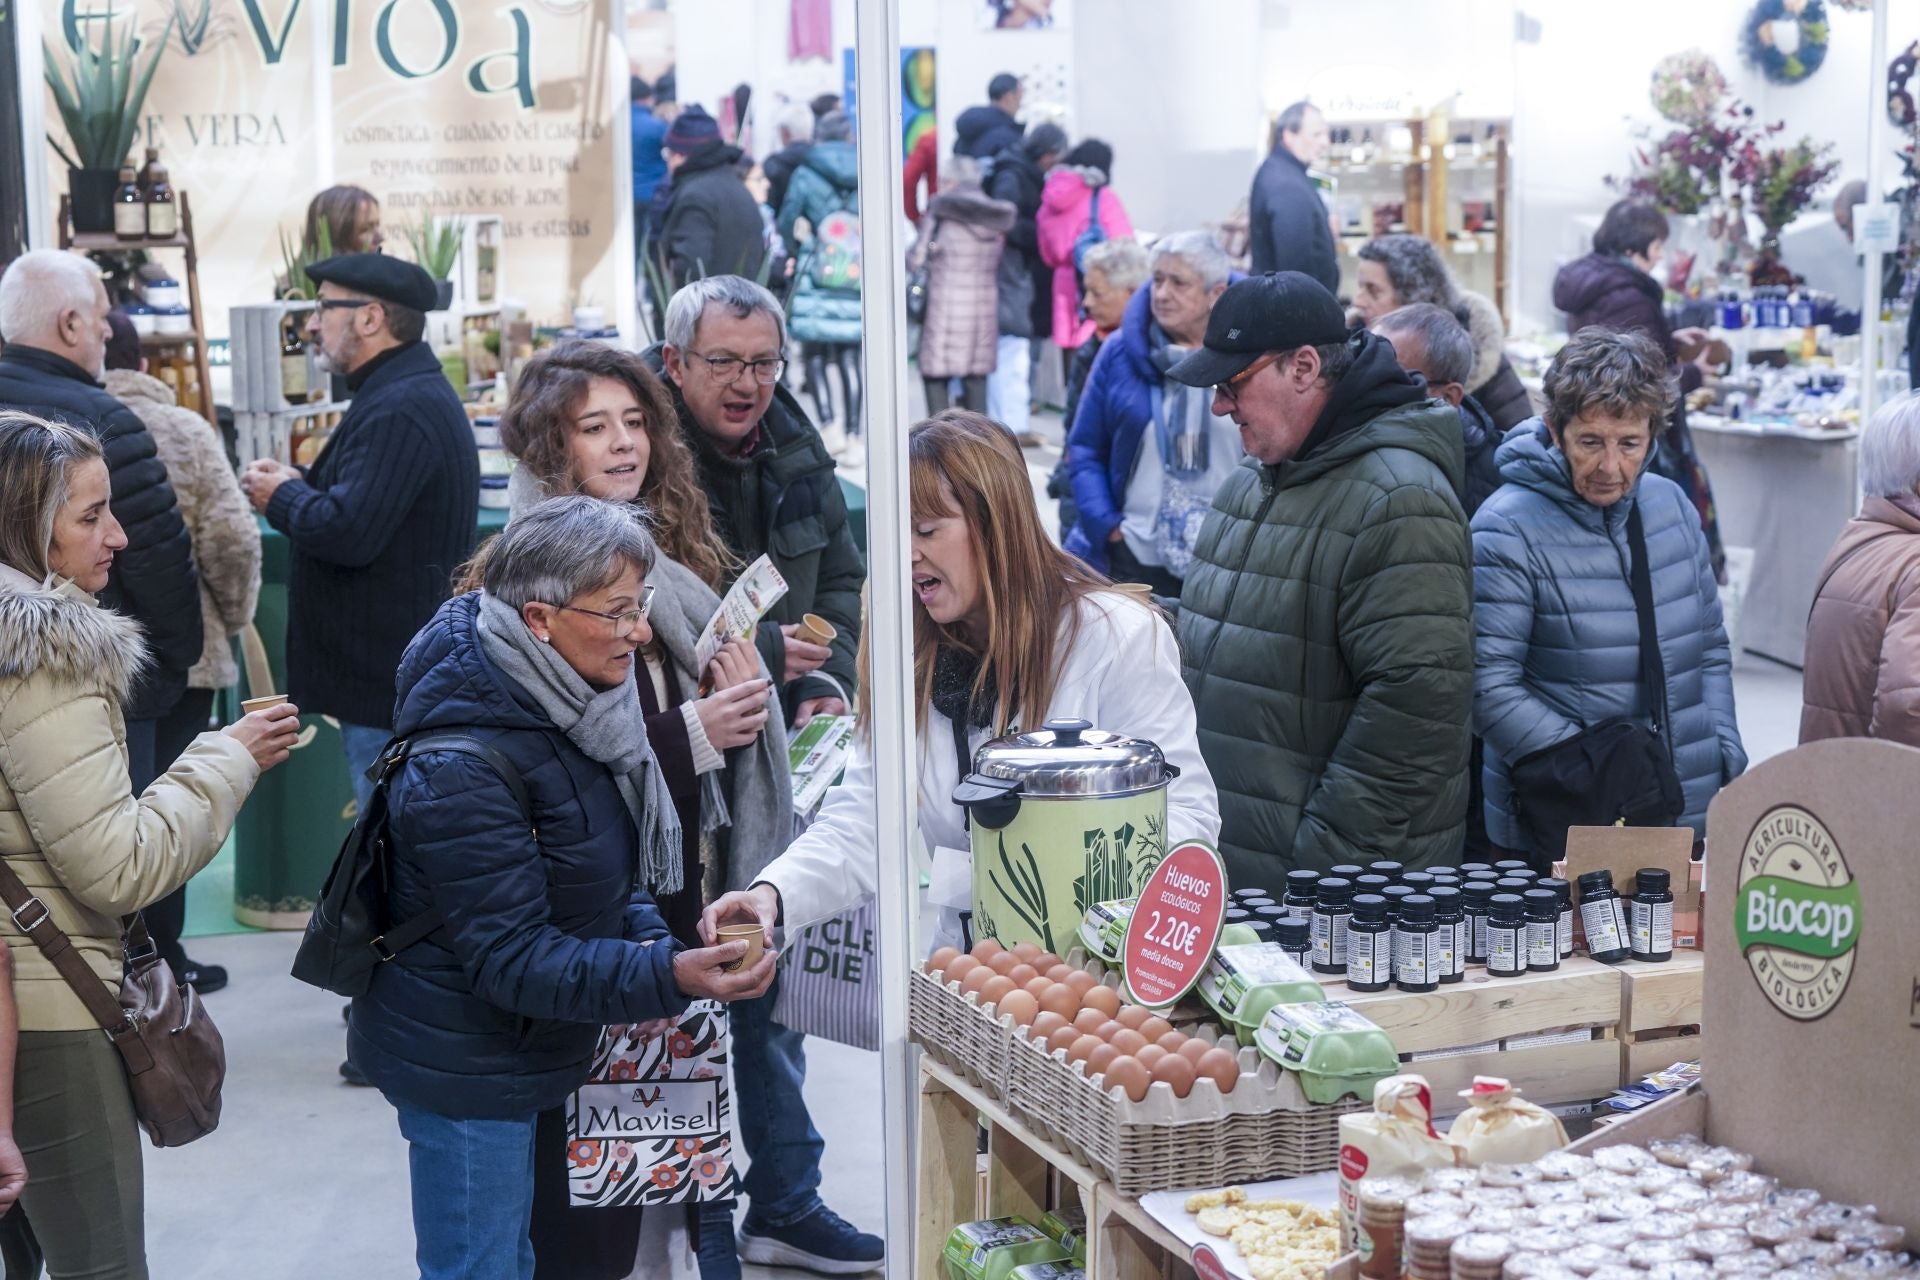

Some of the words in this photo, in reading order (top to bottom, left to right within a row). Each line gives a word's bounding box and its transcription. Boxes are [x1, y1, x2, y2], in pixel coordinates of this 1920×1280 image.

[183, 113, 288, 146] VERA
[1749, 817, 1838, 877] AGRICULTURA
[1165, 864, 1212, 898] Huevos
[1160, 890, 1202, 915] ECOLÓGICOS
[1746, 884, 1854, 948] Biocop
[1144, 910, 1201, 956] 2.20€
[803, 945, 863, 984] DIE
[1140, 947, 1160, 963] media
[1161, 954, 1184, 972] docena
[583, 1100, 712, 1136] Mavisel
